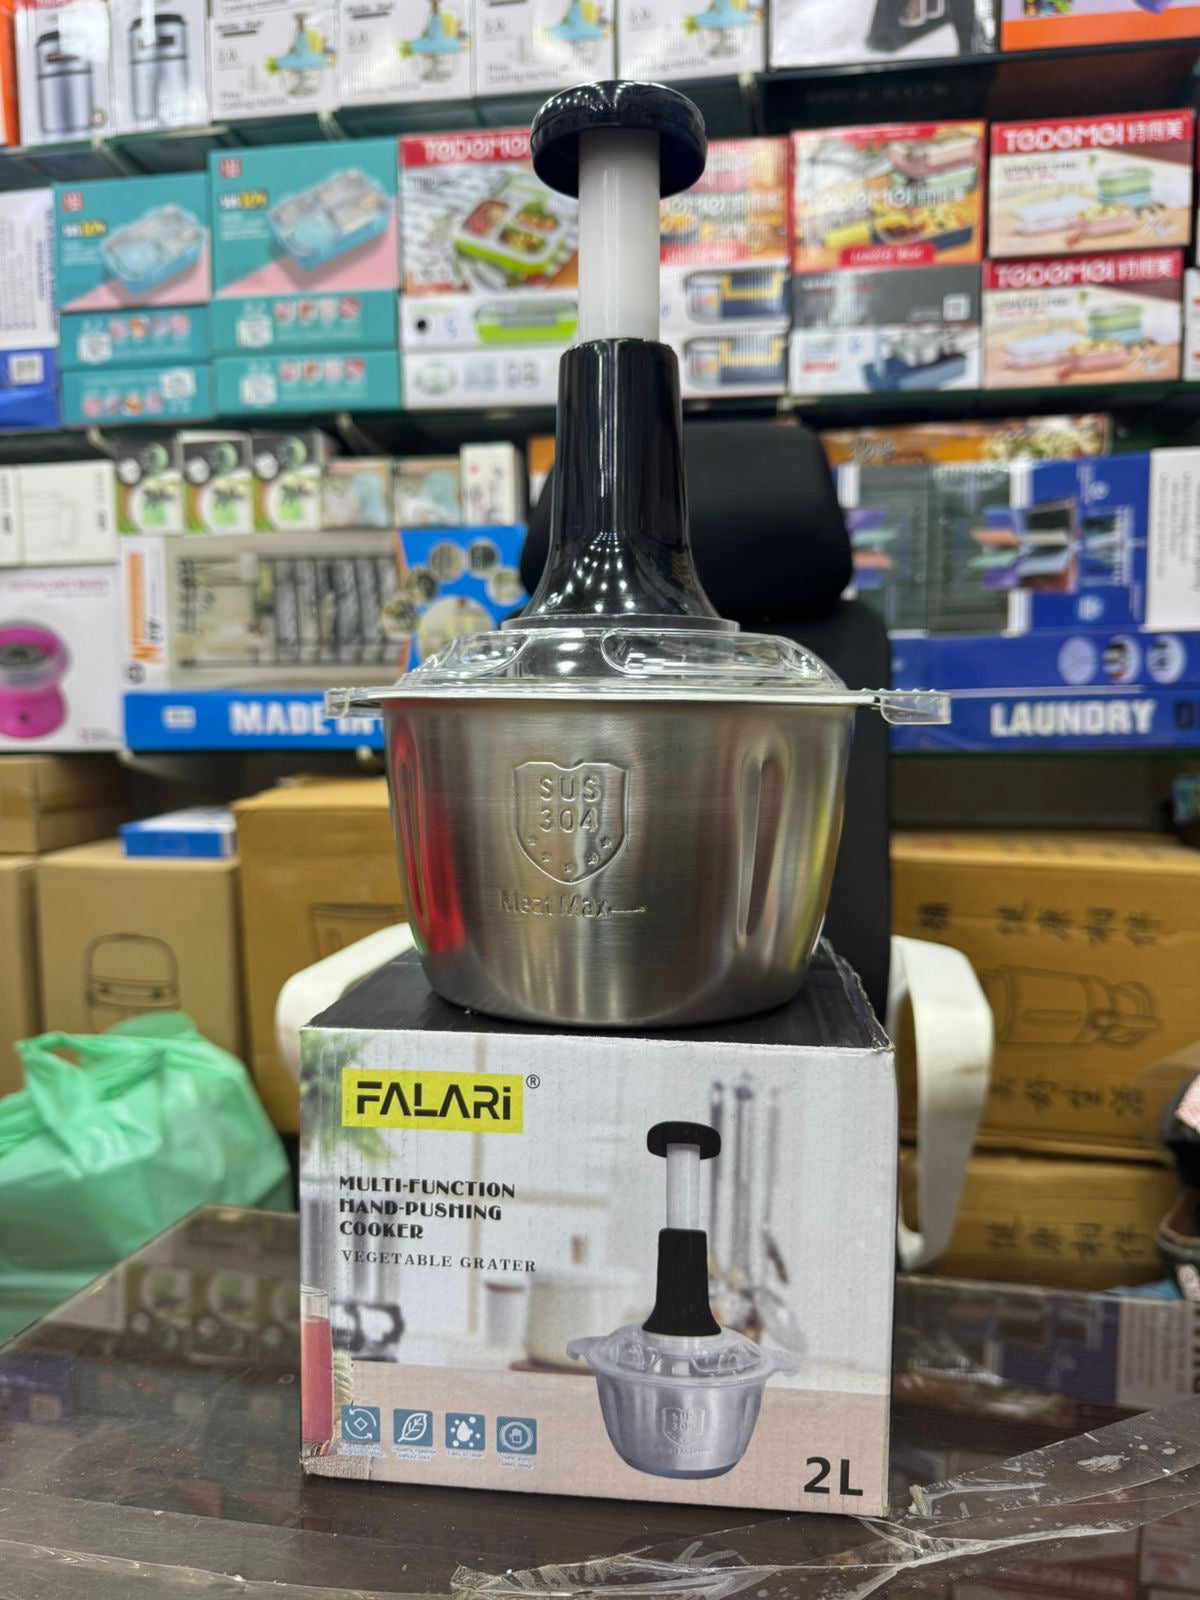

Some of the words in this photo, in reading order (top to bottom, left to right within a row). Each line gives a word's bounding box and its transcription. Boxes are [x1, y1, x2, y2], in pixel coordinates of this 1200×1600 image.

[230, 701, 331, 735] MADE
[990, 699, 1157, 737] LAUNDRY
[540, 775, 601, 803] SUS
[539, 806, 599, 834] 304
[559, 893, 611, 920] Max
[339, 1175, 516, 1198] MULTI-FUNCTION
[339, 1198, 502, 1220] HAND-PUSHING
[339, 1221, 424, 1239] COOKER
[342, 1250, 453, 1268] VEGETABLE
[460, 1257, 537, 1272] GRATER
[804, 1456, 864, 1496] 2L
